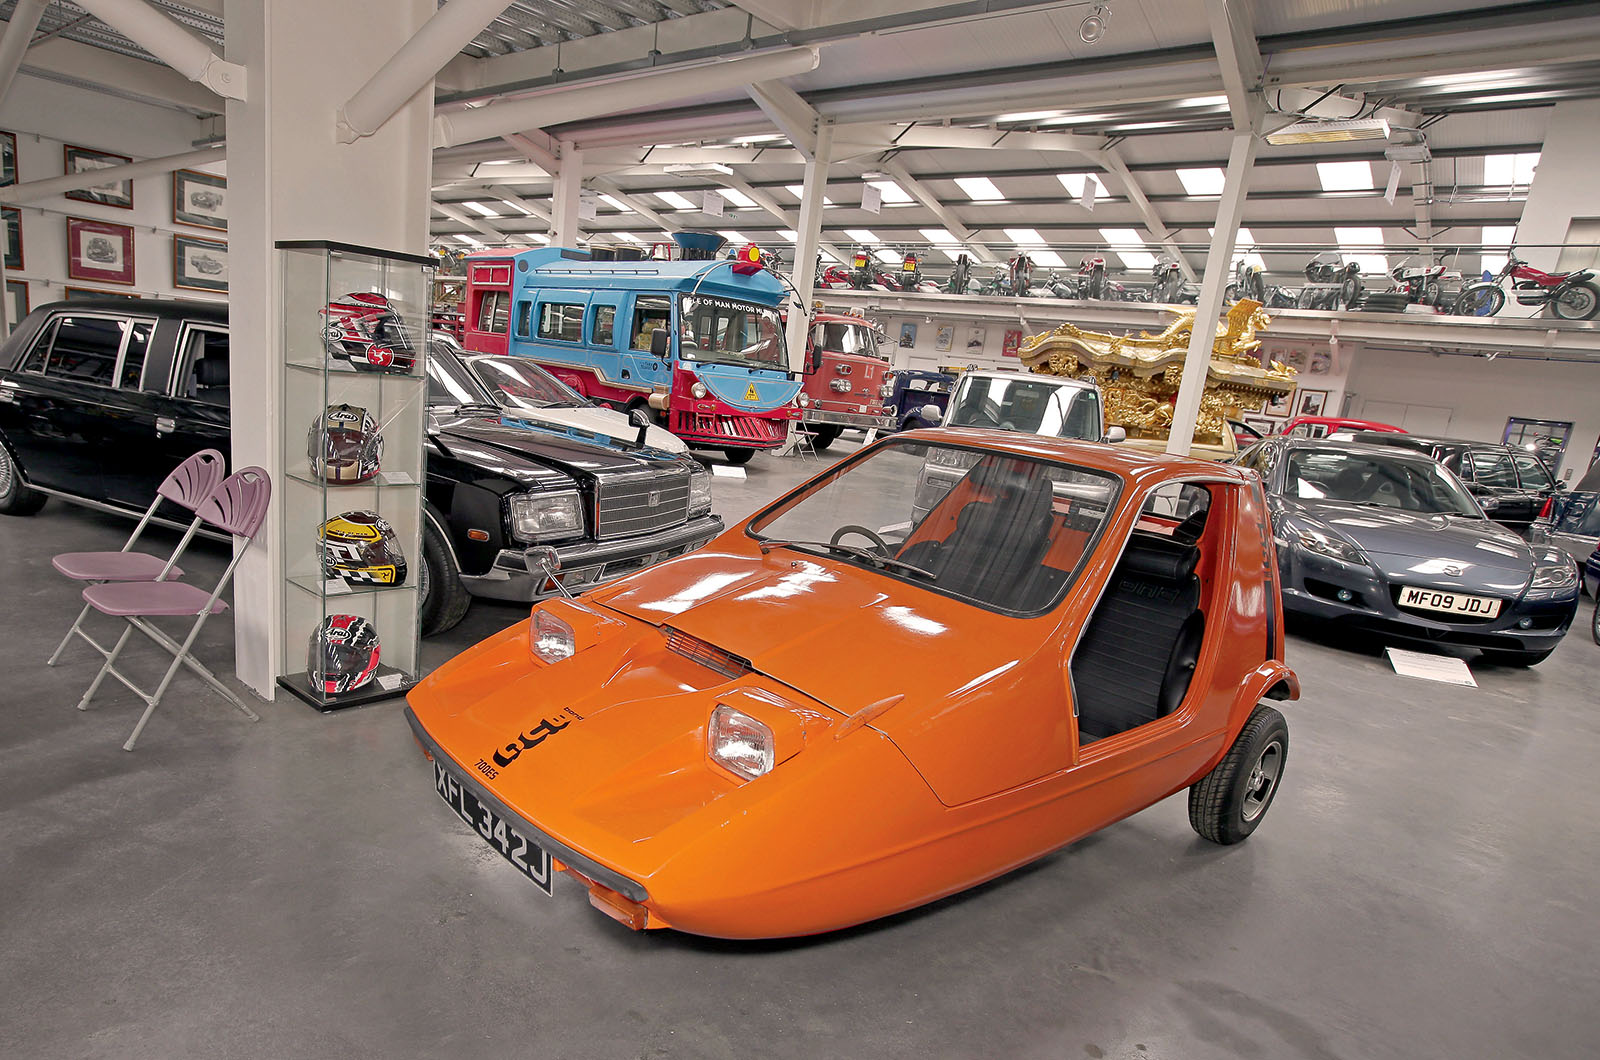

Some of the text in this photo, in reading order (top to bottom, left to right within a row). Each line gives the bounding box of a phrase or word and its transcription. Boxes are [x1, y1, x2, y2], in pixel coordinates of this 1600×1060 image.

[714, 301, 731, 309] MAN
[732, 303, 755, 314] MOTOR
[333, 411, 357, 420] Arai
[1407, 590, 1493, 614] MF09 JDJ
[474, 758, 499, 780] 700ES
[437, 761, 548, 884] XFL 342J
